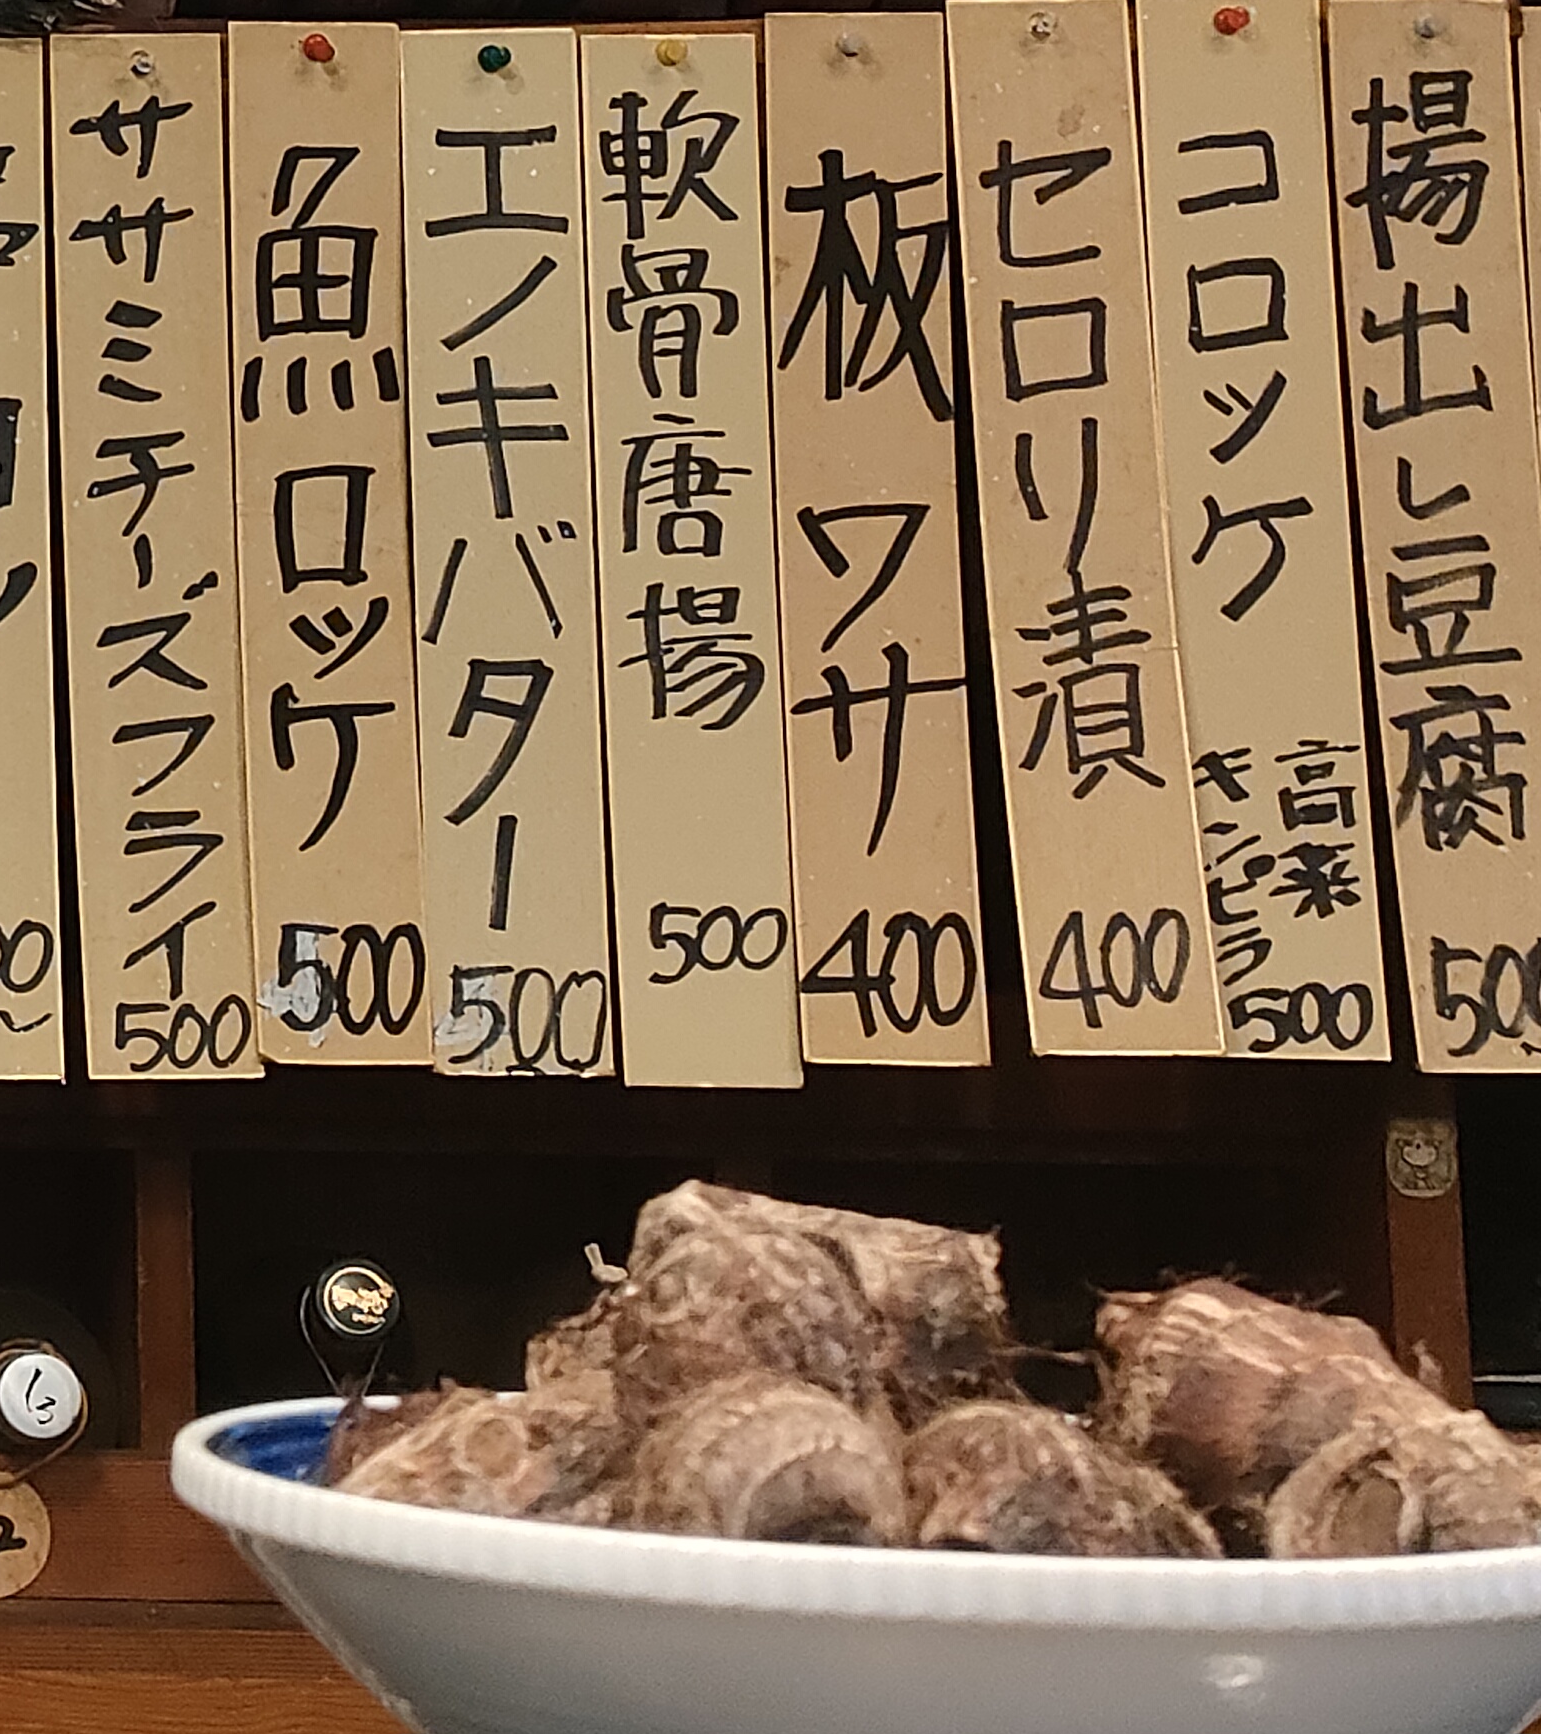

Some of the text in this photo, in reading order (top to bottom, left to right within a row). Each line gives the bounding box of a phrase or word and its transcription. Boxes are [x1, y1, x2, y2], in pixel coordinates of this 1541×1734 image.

[239, 144, 401, 852] 魚ロッケ
[421, 124, 577, 931] エノキバター
[597, 88, 766, 732] 軟骨唐揚
[777, 147, 968, 859] 板ワサ
[978, 138, 1167, 800] セロリ漬
[1176, 129, 1315, 620] コロッケ
[1344, 68, 1525, 852] 揚出し豆腐
[69, 95, 225, 1001] ササミチーズフライ
[274, 921, 425, 1035] 500
[648, 903, 788, 983] 500
[797, 909, 978, 1038] 400
[1038, 907, 1191, 1029] 400
[1269, 739, 1362, 919] 高菜
[114, 994, 252, 1072] 500
[446, 963, 608, 1066] 500
[1226, 981, 1374, 1053] 500
